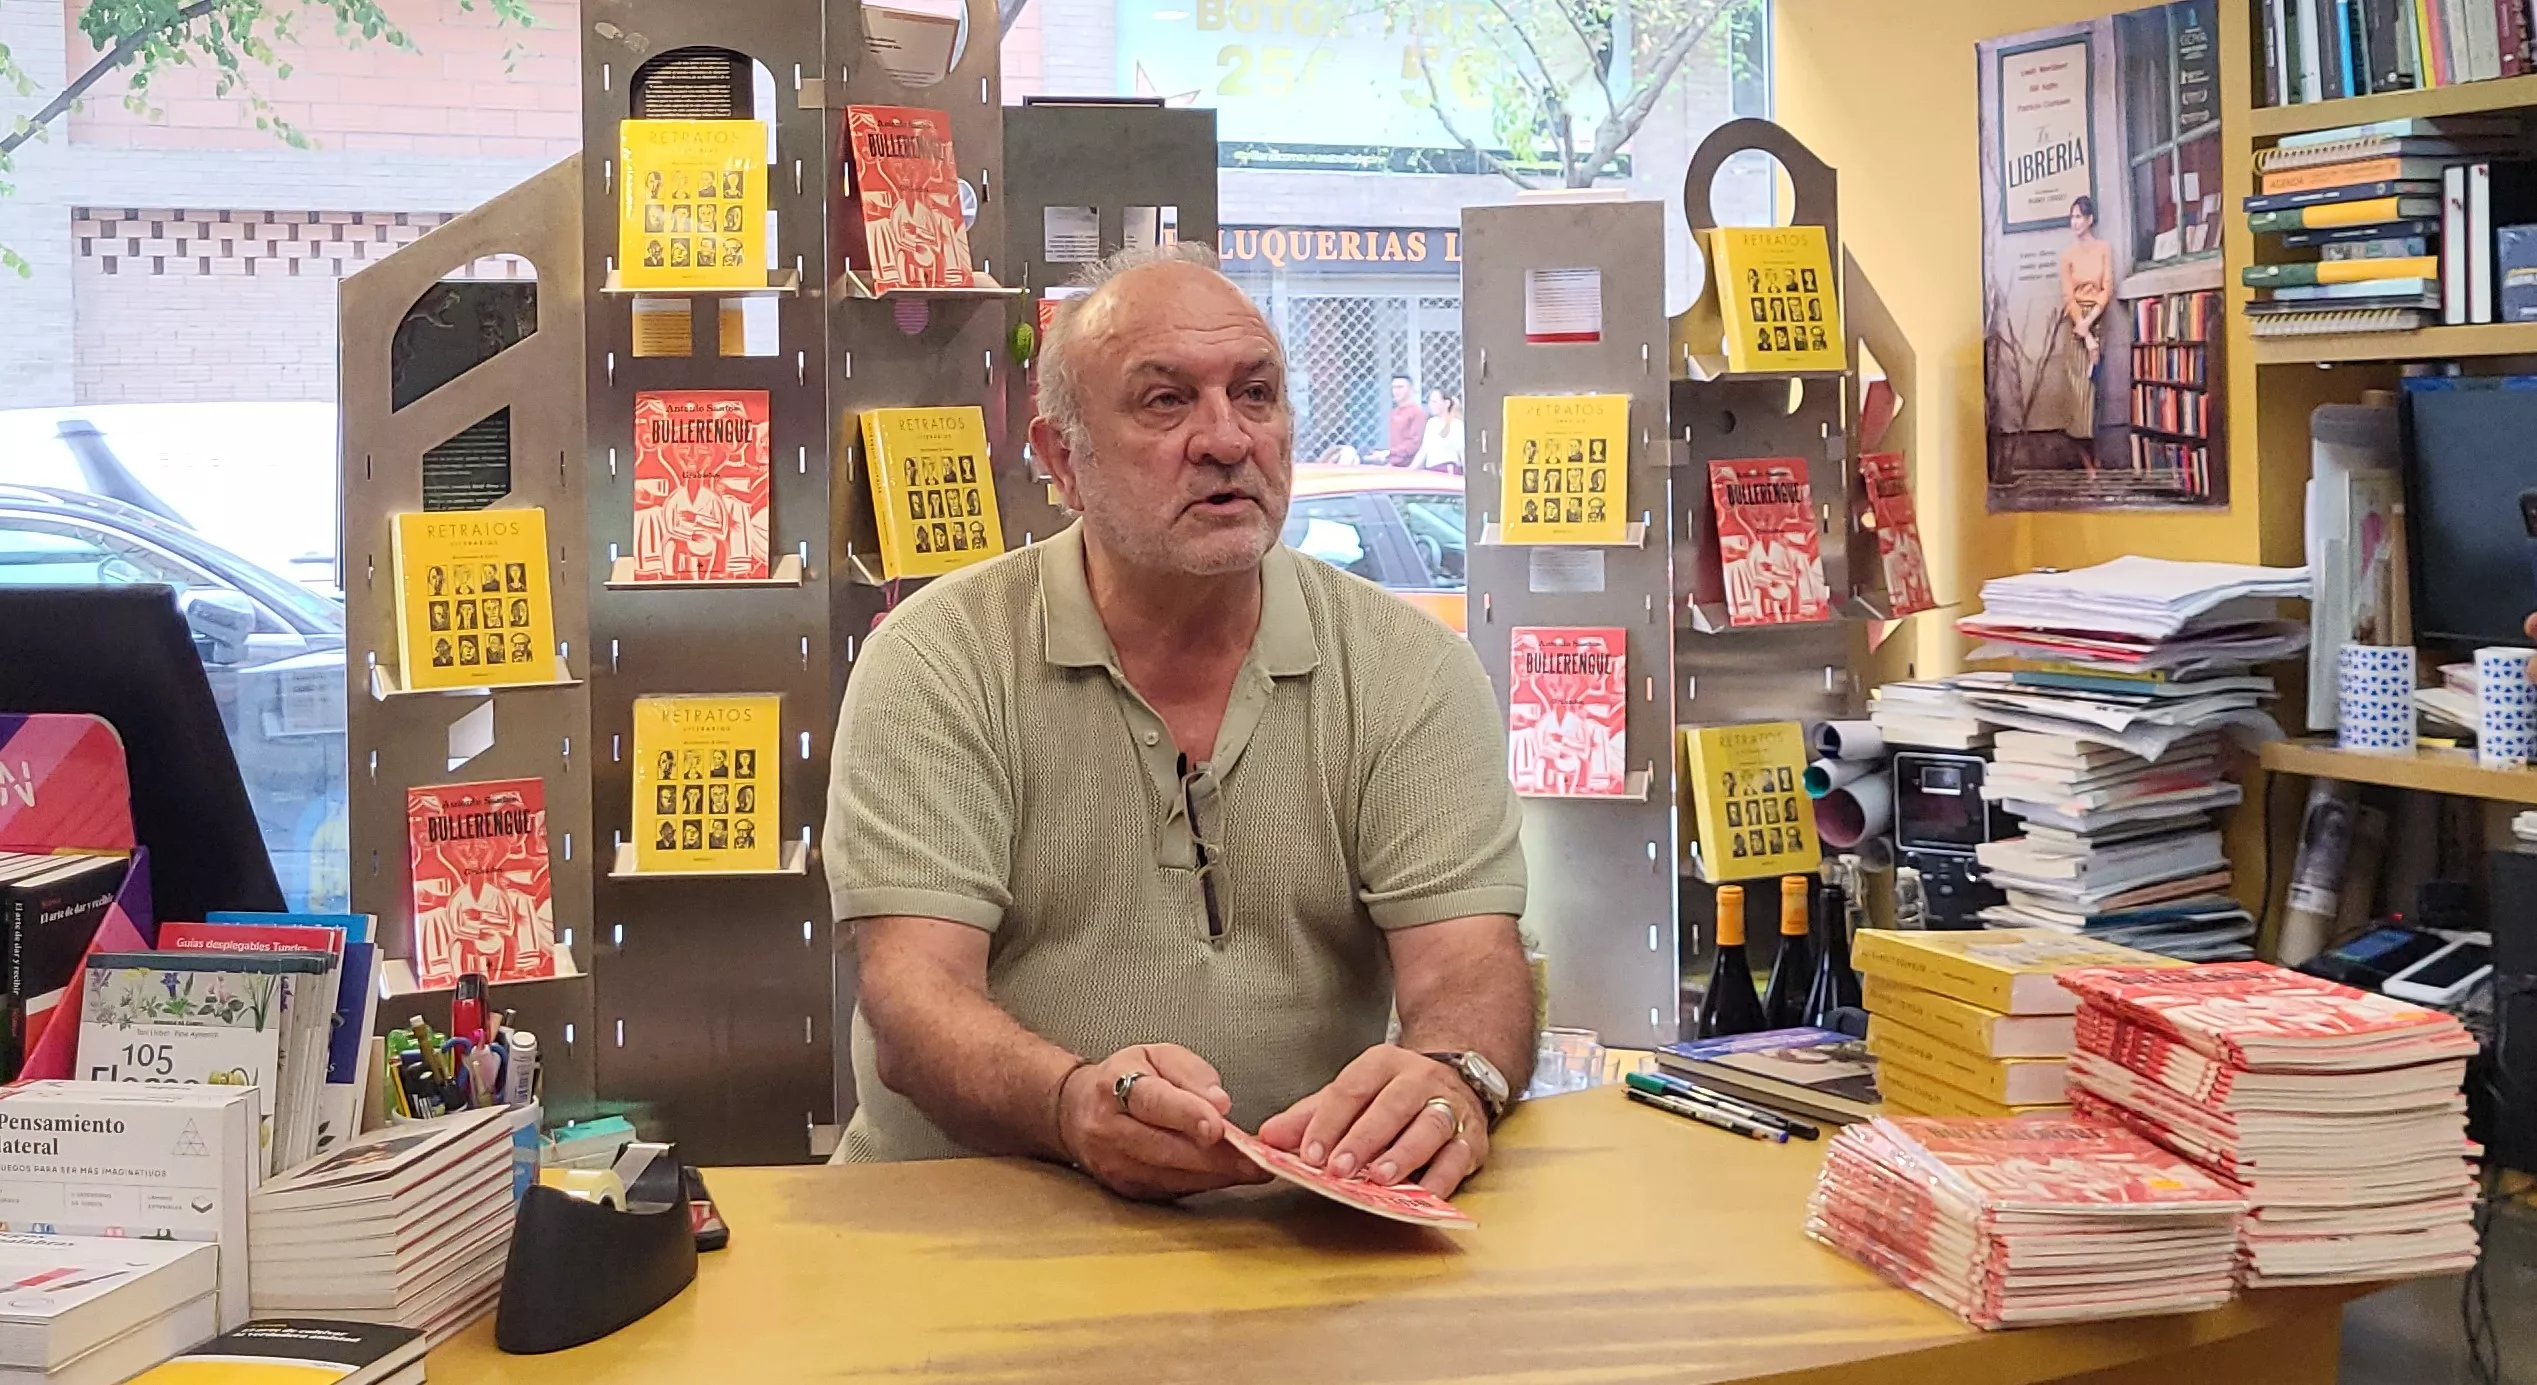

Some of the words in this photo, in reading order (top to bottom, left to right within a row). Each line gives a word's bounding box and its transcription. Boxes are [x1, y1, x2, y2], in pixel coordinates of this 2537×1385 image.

[2008, 132, 2085, 189] LIBRERÍA
[1217, 229, 1427, 268] LUQUERIAS
[652, 419, 753, 444] BULLERENGUE
[899, 417, 965, 431] RETRATOS
[1526, 652, 1612, 675] BULLERENGUE
[662, 708, 752, 722] RETRATOS
[428, 809, 531, 843] BULLERENGUE
[206, 939, 270, 952] desplegables
[122, 1043, 173, 1075] 105
[0, 1113, 125, 1134] Pensamiento
[0, 1164, 31, 1173] UEGOS
[34, 1165, 57, 1173] PARA
[101, 1168, 167, 1178] IMAGINATIVOS
[0, 1239, 74, 1247] alabras
